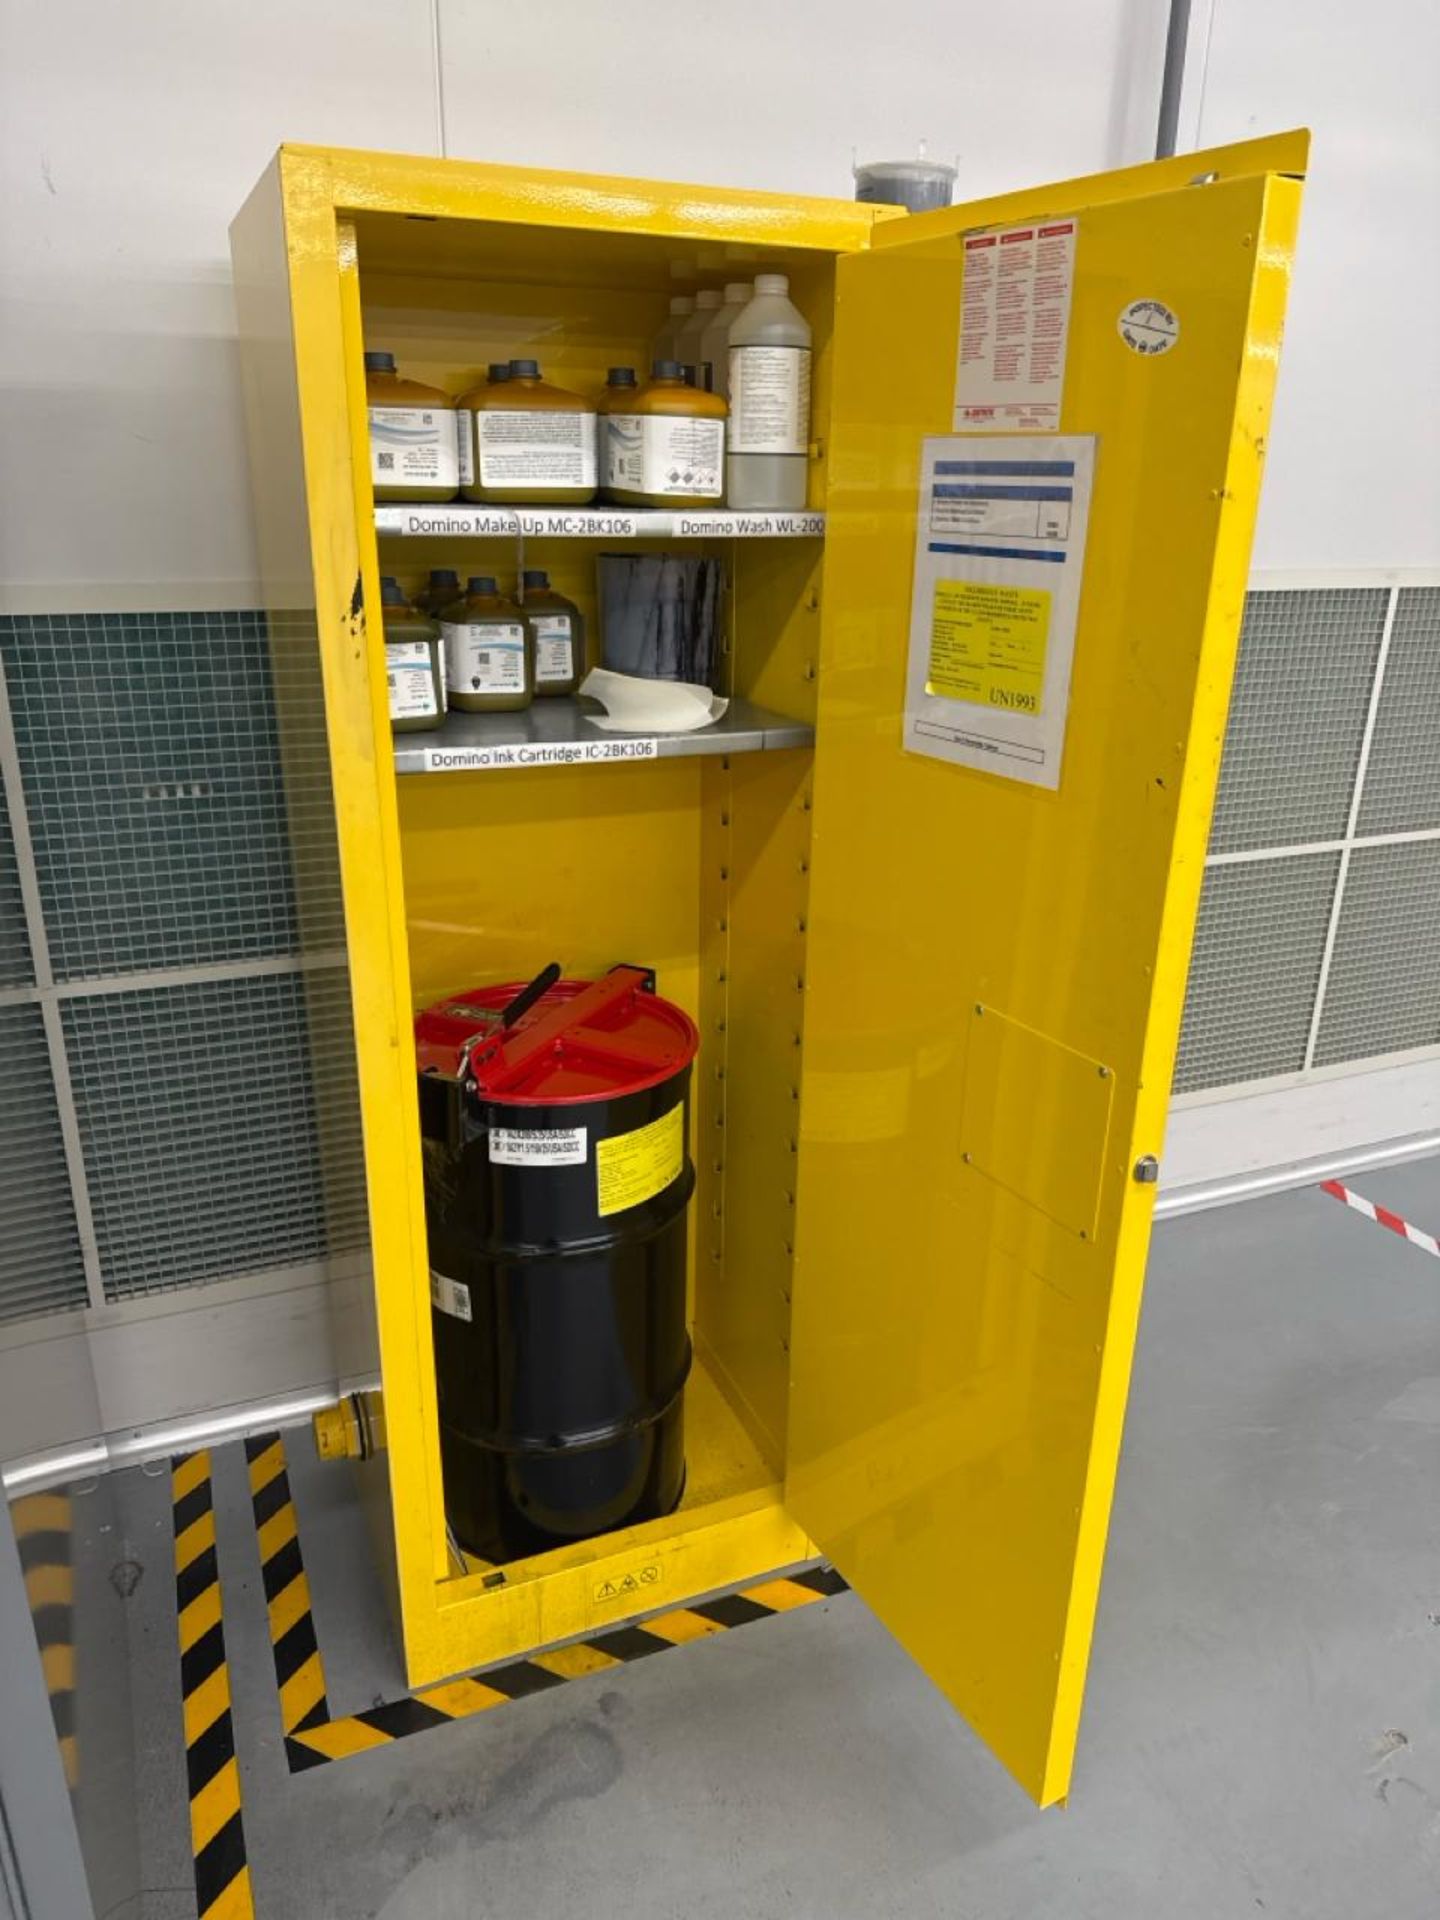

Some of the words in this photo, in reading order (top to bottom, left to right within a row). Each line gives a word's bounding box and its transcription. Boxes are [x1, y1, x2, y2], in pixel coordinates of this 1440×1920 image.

[409, 516, 471, 533] Domino
[475, 516, 517, 533] Make
[523, 518, 544, 535] Up
[548, 518, 632, 534] MC-2BK106
[681, 520, 732, 534] Domino
[736, 519, 772, 533] Wash
[776, 518, 825, 533] WL-200
[431, 752, 490, 767] Domino
[494, 751, 514, 764] Ink
[519, 748, 582, 764] Cartridge
[586, 742, 653, 759] IC-2BK106
